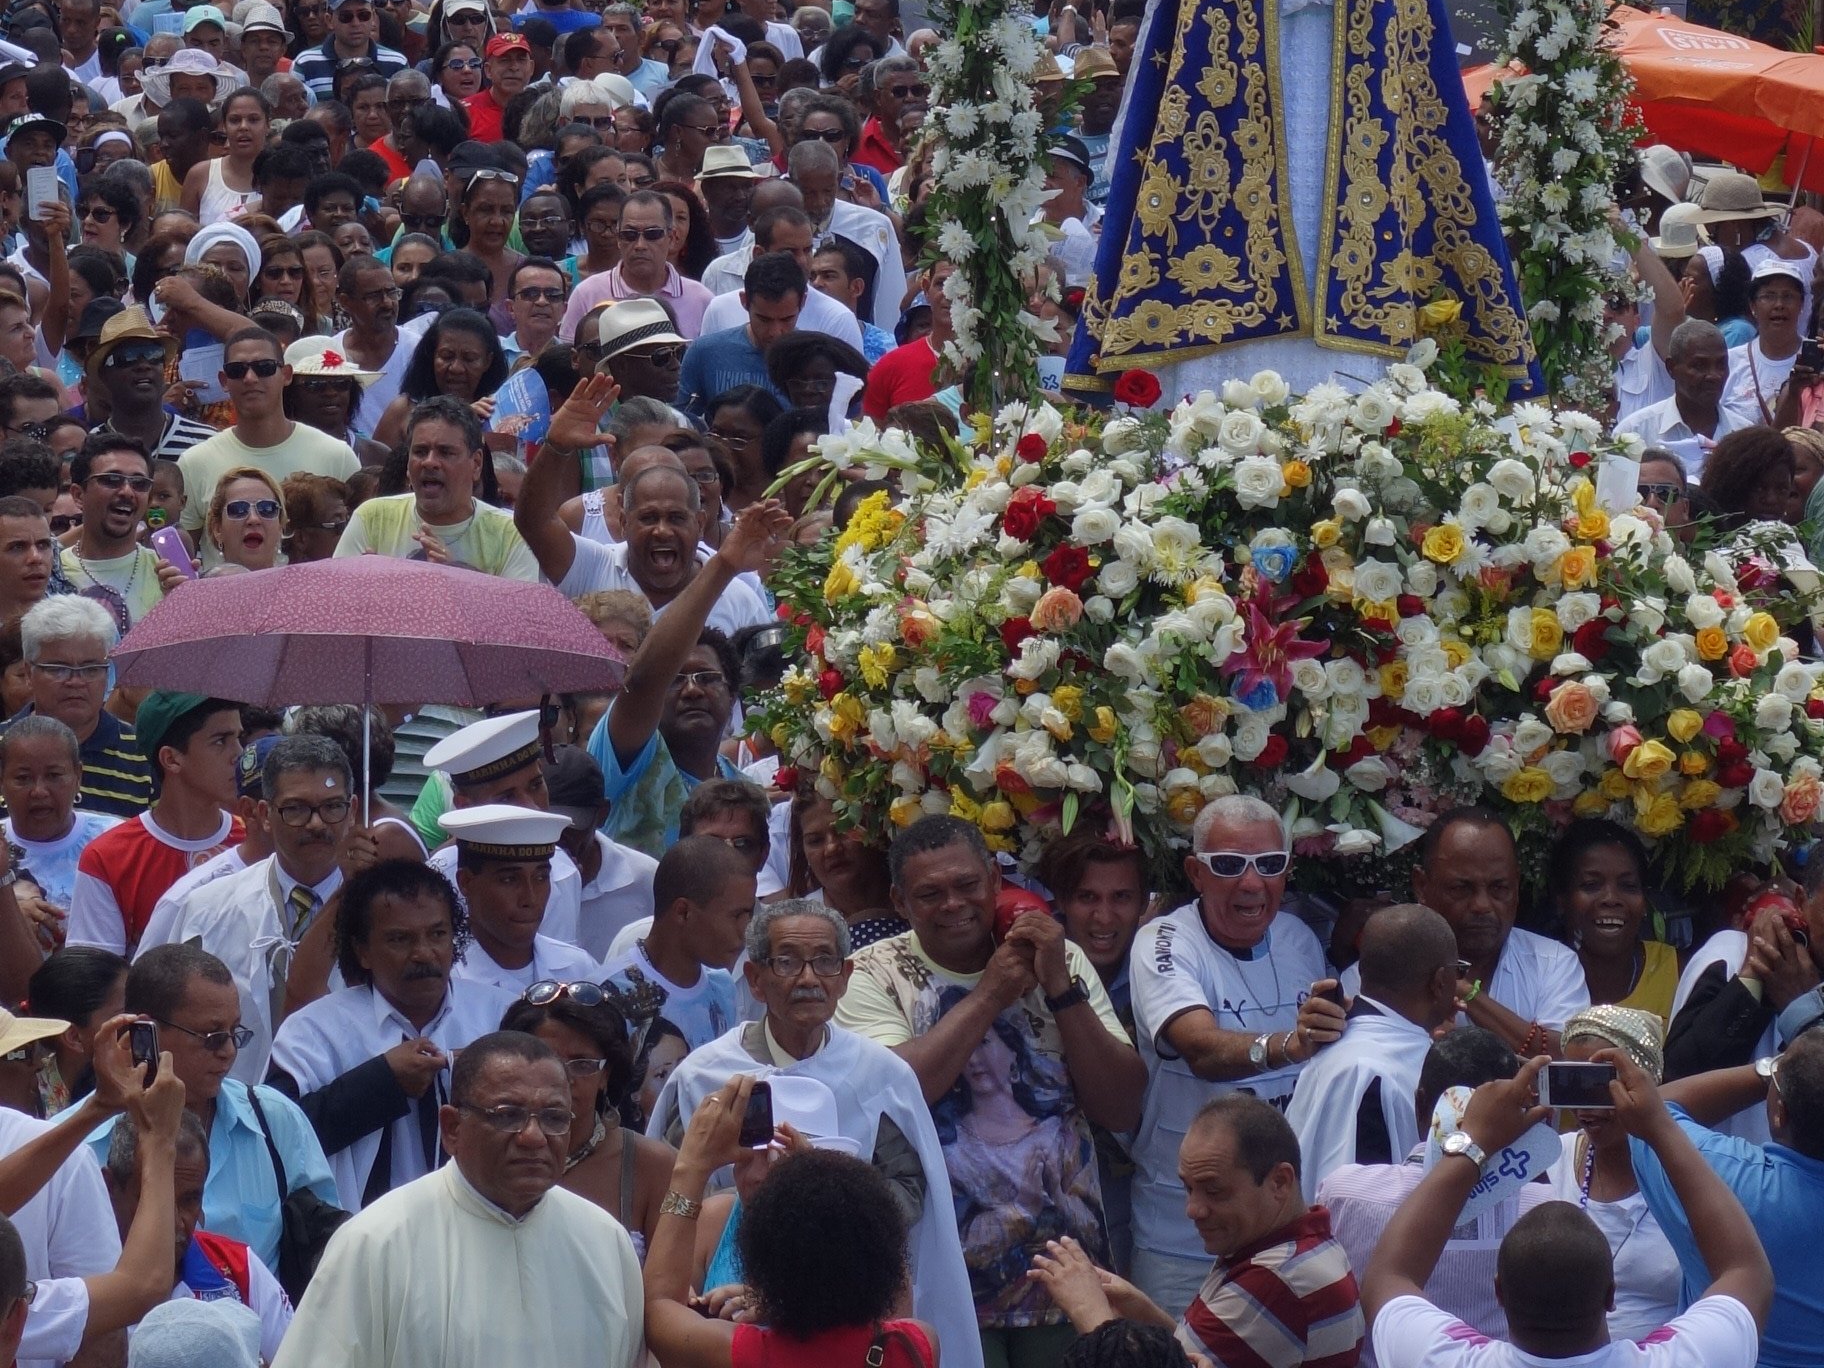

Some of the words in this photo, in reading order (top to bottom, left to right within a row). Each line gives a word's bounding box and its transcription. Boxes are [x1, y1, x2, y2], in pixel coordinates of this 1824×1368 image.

[469, 757, 516, 778] MARINHA
[469, 842, 516, 856] MARINHA
[518, 846, 533, 856] DO
